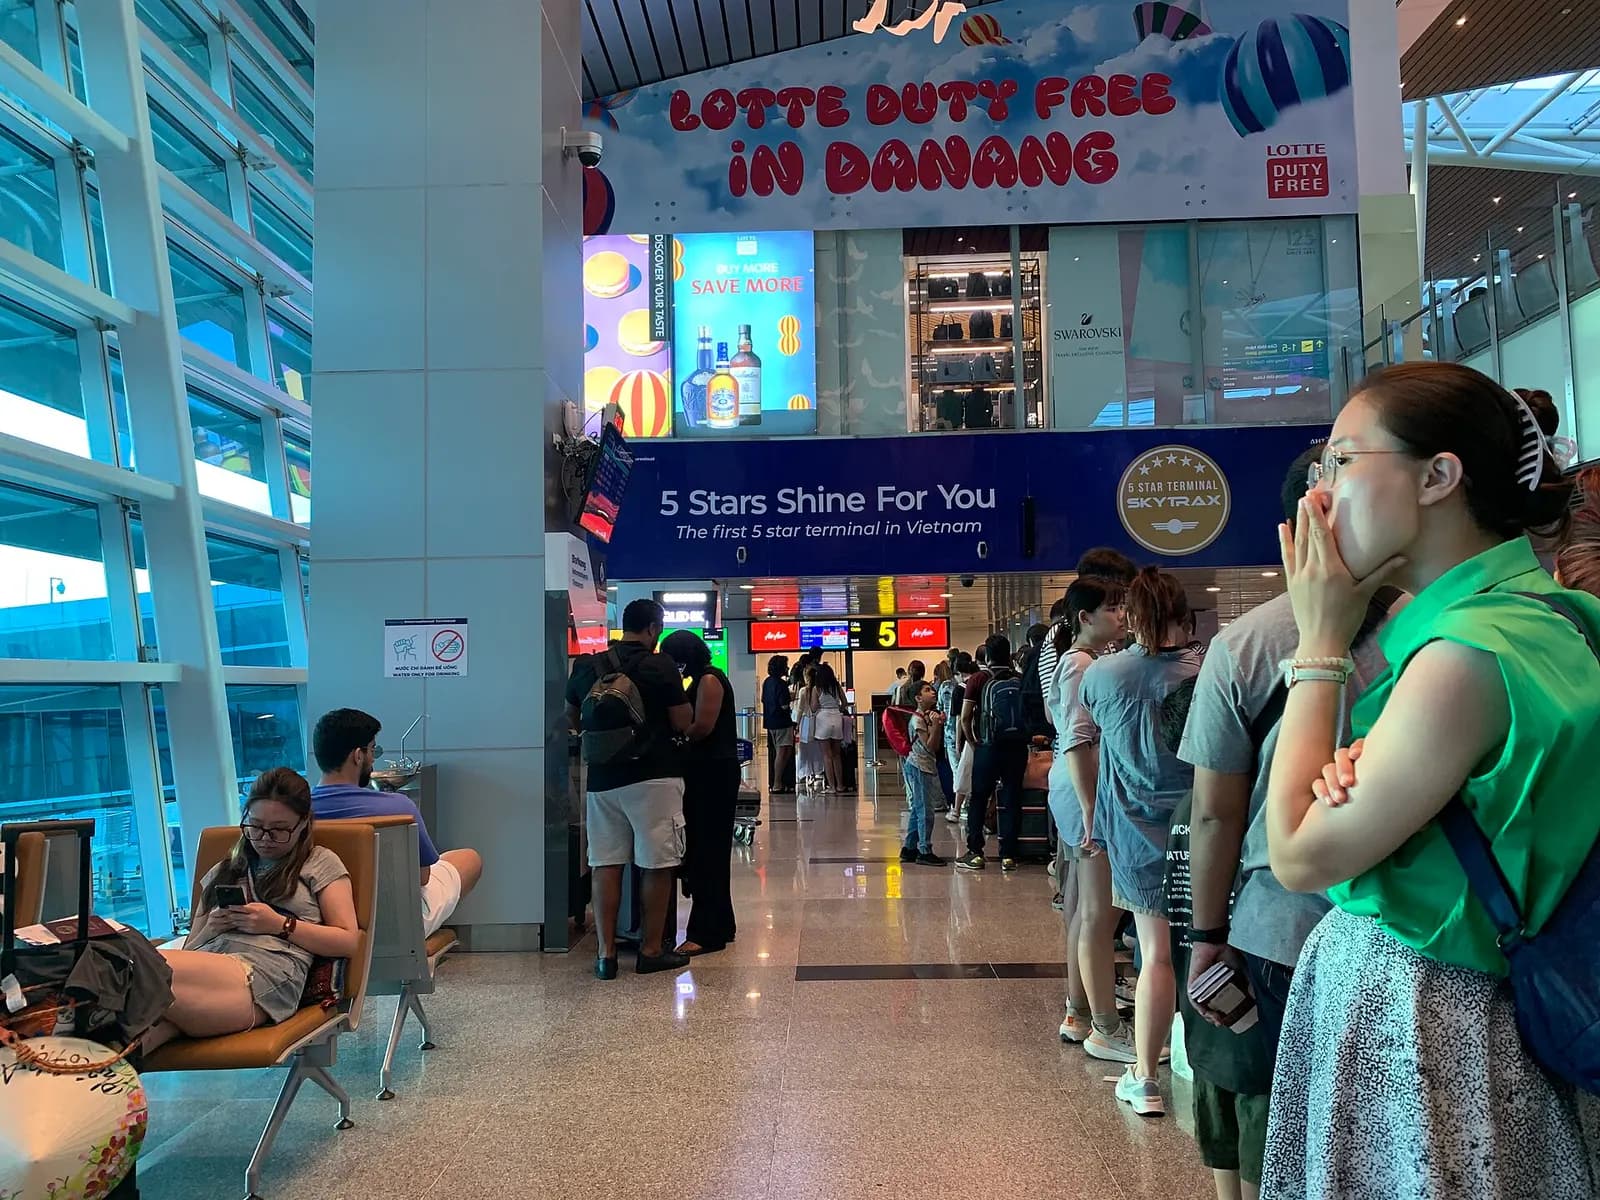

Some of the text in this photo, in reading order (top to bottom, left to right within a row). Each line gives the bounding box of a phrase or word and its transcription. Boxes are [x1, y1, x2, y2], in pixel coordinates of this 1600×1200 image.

[669, 73, 1177, 131] LOTTE DUTY FREE
[1267, 144, 1326, 156] LOTTE
[825, 131, 1119, 194] DANANG
[1273, 163, 1322, 177] DUTY
[1274, 178, 1323, 192] FREE
[743, 262, 780, 273] MORE
[654, 234, 665, 337] DISCOVER YOUR TASTE
[691, 276, 804, 295] SAVE MORE
[1054, 327, 1122, 340] SWAROVSKI
[1128, 480, 1218, 493] 5 STAR TERMINAL
[660, 483, 996, 516] 5 Stars Shine For You
[1127, 494, 1221, 509] SKYTRAX
[676, 520, 982, 540] The first 5 star terminal in Vietnam
[878, 621, 897, 648] 5
